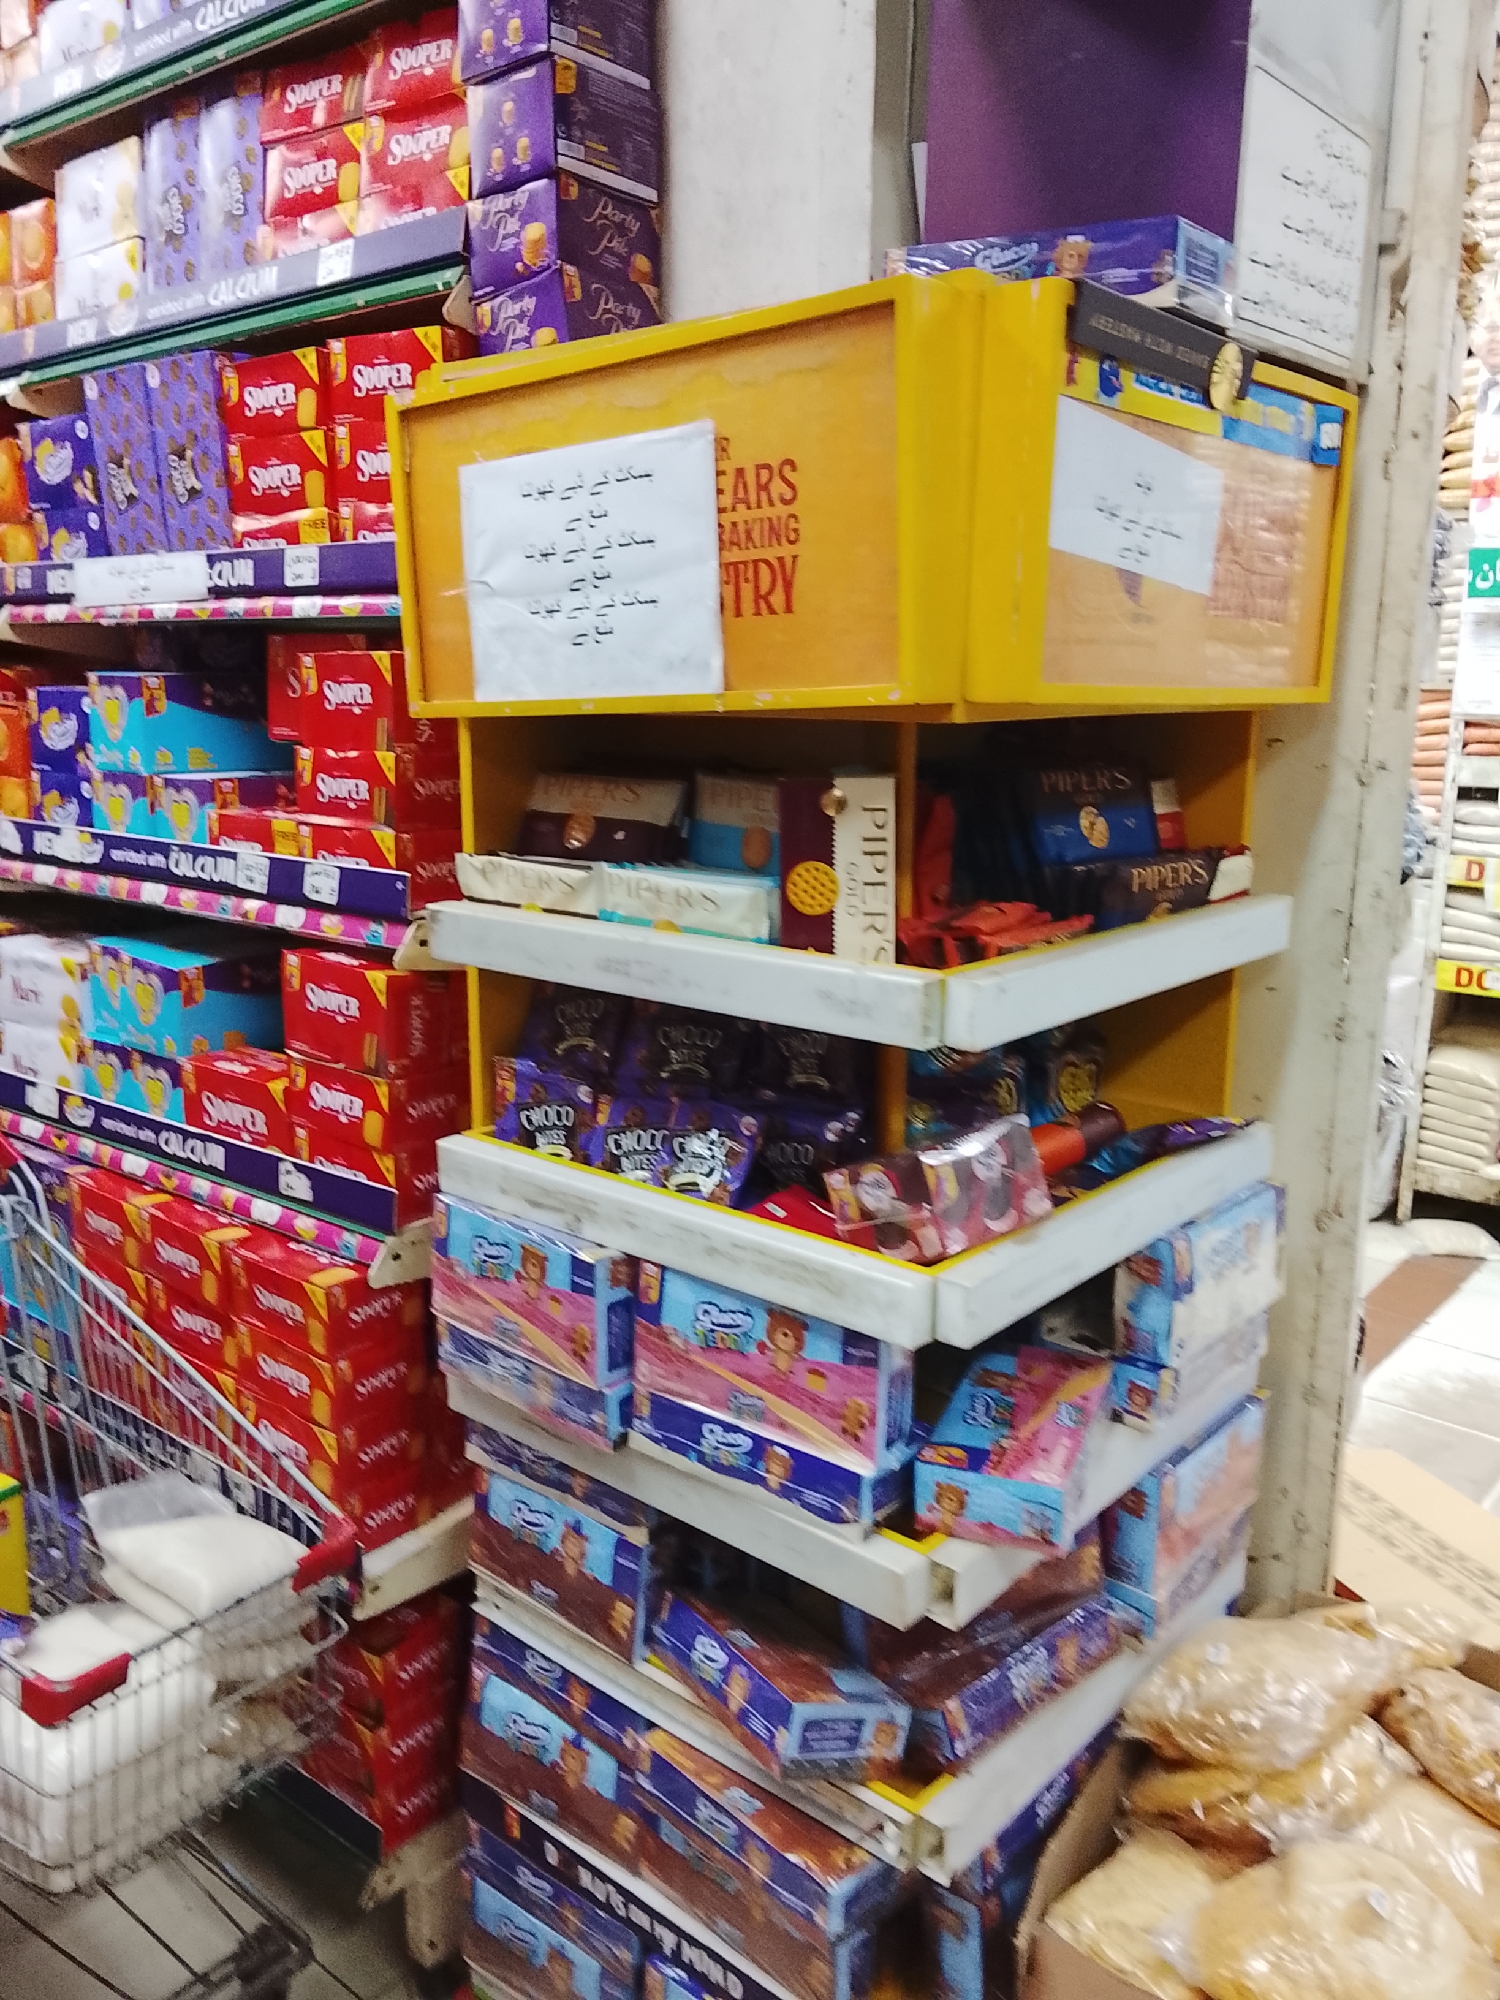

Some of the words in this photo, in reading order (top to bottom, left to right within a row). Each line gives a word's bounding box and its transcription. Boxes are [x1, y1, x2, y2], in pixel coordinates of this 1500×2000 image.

[387, 38, 453, 81] SOOPER
[284, 74, 343, 113] SOOPER
[387, 125, 452, 166] SOOPER
[283, 158, 337, 199] SOOPER
[581, 196, 641, 238] Party
[586, 283, 642, 325] Party
[353, 363, 413, 397] SOOPER
[243, 383, 297, 418] SOOPER
[248, 464, 302, 497] SOOPER
[356, 450, 391, 482] SOO
[590, 470, 610, 496] کے
[593, 534, 613, 560] کے
[595, 593, 616, 617] کے
[719, 555, 800, 618] TRY
[322, 680, 374, 711] SOOPER
[315, 773, 370, 803] SOOPER
[304, 982, 361, 1020] SOOPER
[201, 1090, 269, 1136] SOOPER
[308, 1080, 364, 1119] SOOPER
[519, 1104, 576, 1131] CHOCO
[158, 1129, 226, 1172] CALCIUM
